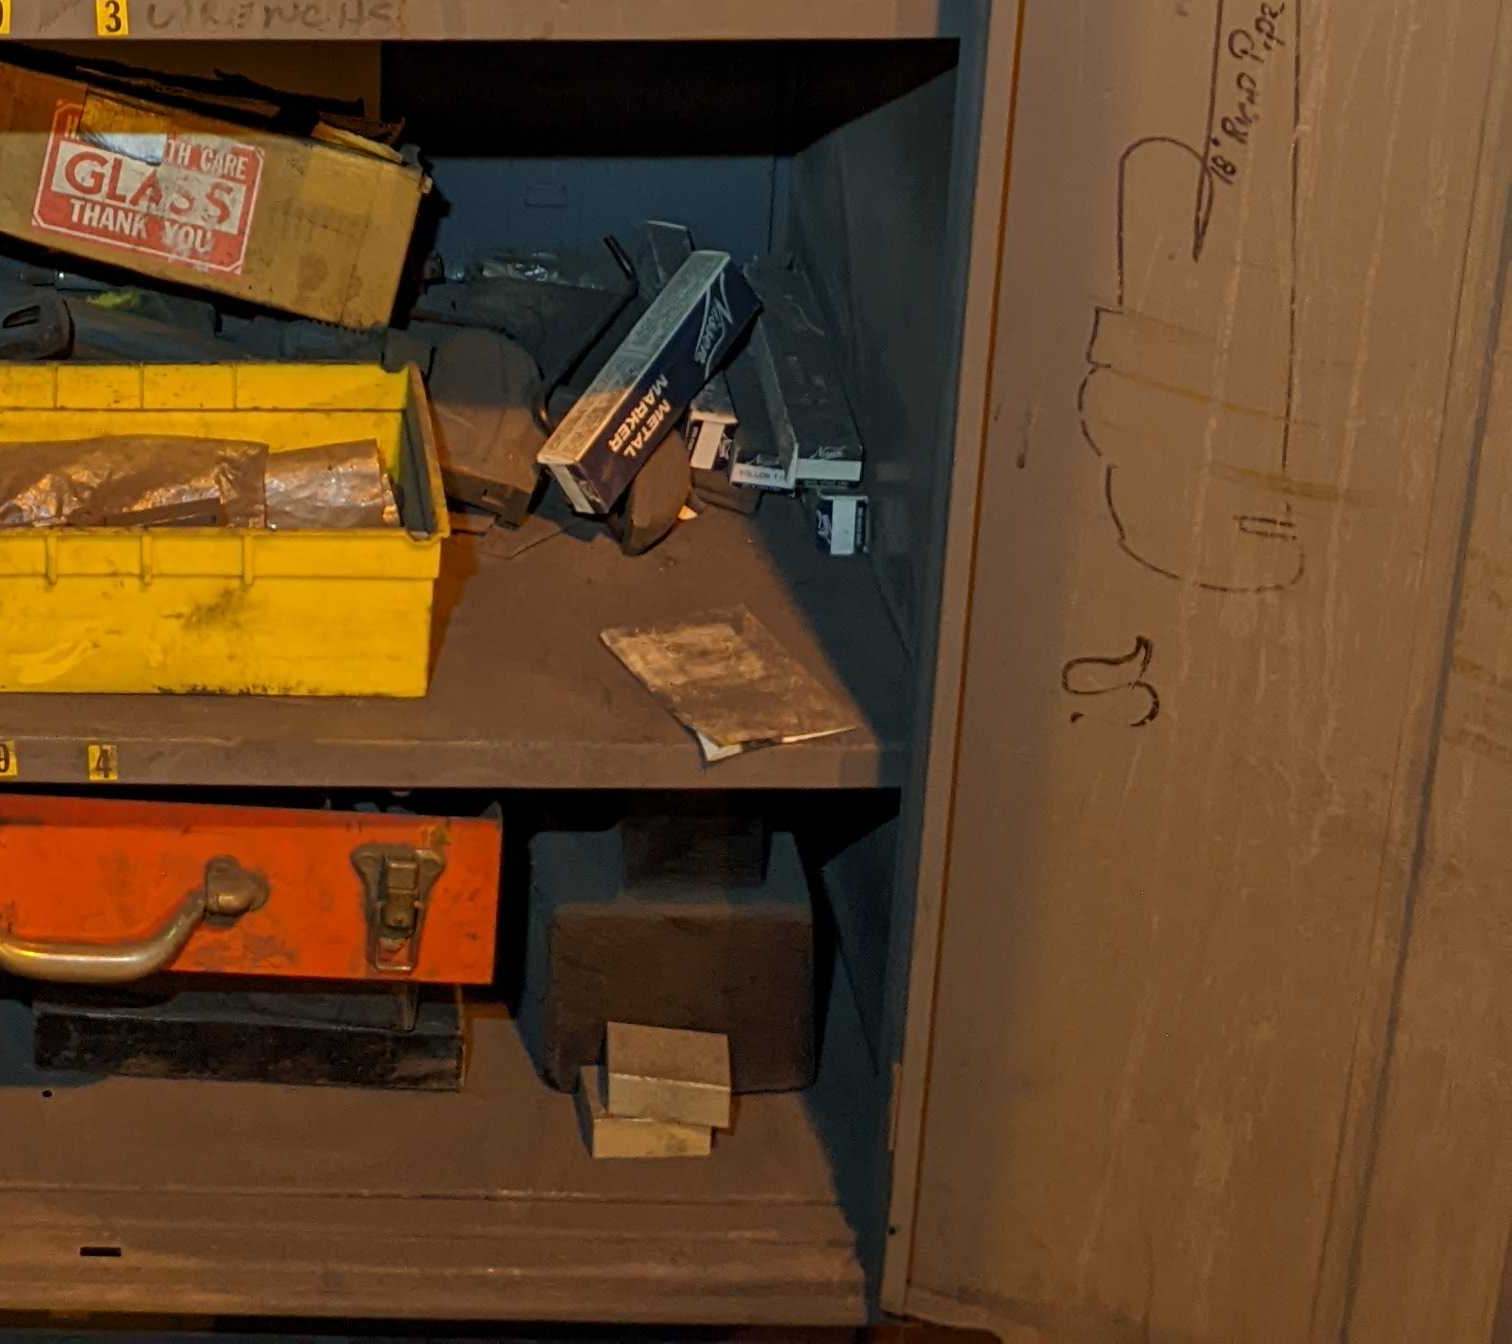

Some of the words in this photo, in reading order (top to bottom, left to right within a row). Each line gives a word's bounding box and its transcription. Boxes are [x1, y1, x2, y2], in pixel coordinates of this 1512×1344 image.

[104, 0, 122, 34] 3
[64, 149, 236, 226] GLASS
[199, 147, 250, 179] CARE
[70, 197, 148, 240] THANK
[160, 218, 214, 256] YOU
[608, 373, 669, 453] MARKER
[623, 398, 672, 458] METAL
[95, 747, 113, 779] 4
